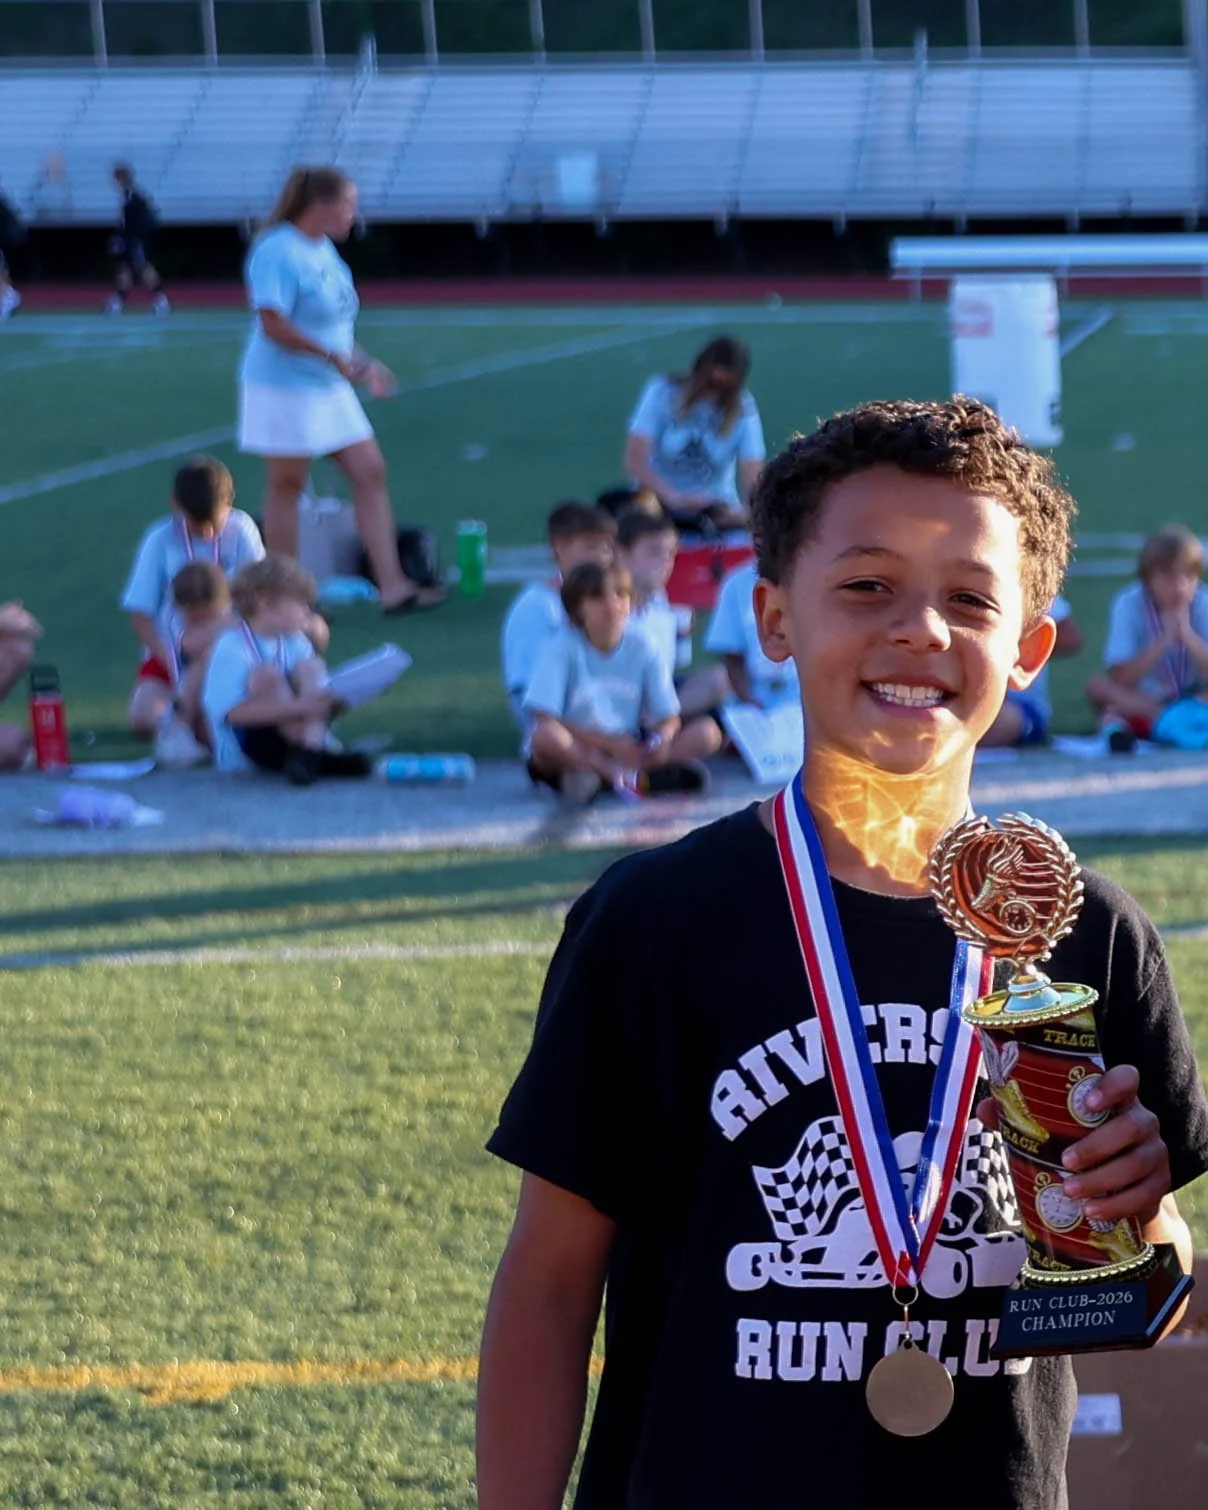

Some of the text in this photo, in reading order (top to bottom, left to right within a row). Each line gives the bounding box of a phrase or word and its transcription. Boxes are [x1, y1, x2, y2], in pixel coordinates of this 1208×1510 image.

[1009, 1298, 1042, 1313] RUN
[1022, 1310, 1117, 1332] CHAMPION
[735, 1318, 1032, 1381] RUN CLU
